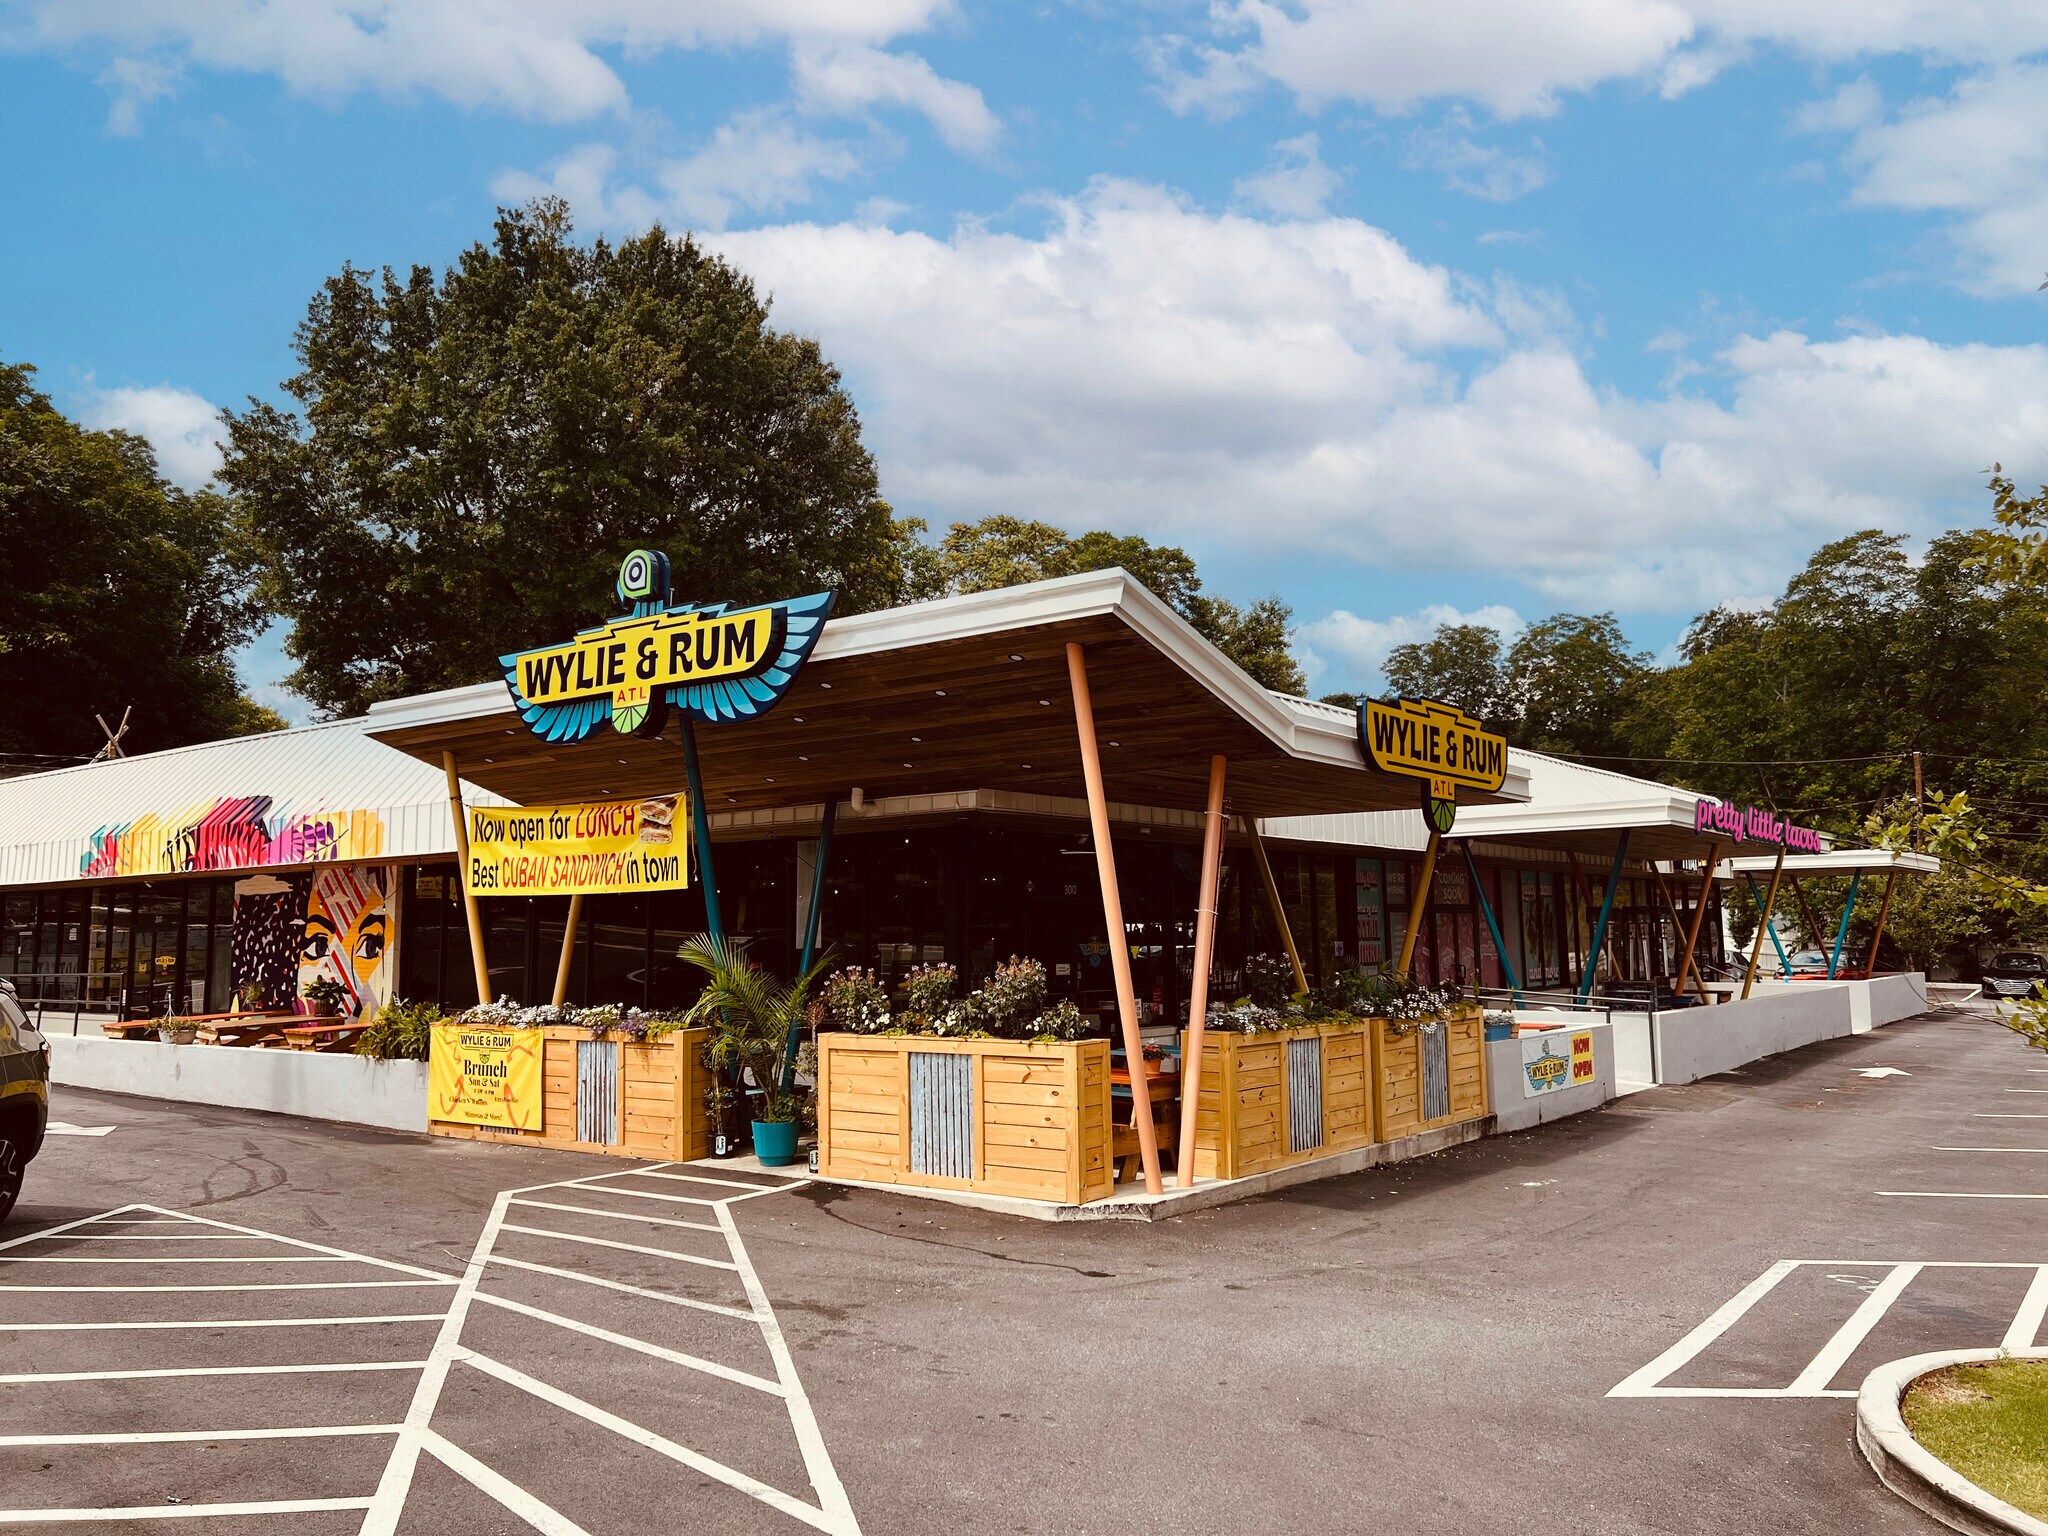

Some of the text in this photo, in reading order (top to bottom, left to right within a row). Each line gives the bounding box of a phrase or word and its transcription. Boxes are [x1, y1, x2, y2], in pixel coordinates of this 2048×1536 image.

[524, 619, 756, 699] WYLIE & RUM
[616, 686, 646, 703] ATL
[1374, 712, 1502, 776] WYLIE & RUM
[1433, 780, 1452, 796] ATL
[474, 804, 637, 848] Now open for LUNCH
[1697, 800, 1820, 852] pretty little tacos
[472, 852, 679, 888] Best CUBAN SANDWICH in town
[1386, 873, 1406, 883] WE'RE
[1440, 872, 1465, 885] COMING
[1064, 885, 1076, 894] 300
[1387, 886, 1406, 895] HIRING
[1443, 888, 1463, 900] SOON
[460, 1035, 511, 1047] WYLIE & RUM
[1573, 1038, 1590, 1055] NOW
[464, 1059, 507, 1078] Brunch
[1532, 1064, 1548, 1078] WYLIE
[1573, 1060, 1592, 1078] OPEN
[469, 1077, 480, 1086] Sun
[482, 1078, 488, 1086] &
